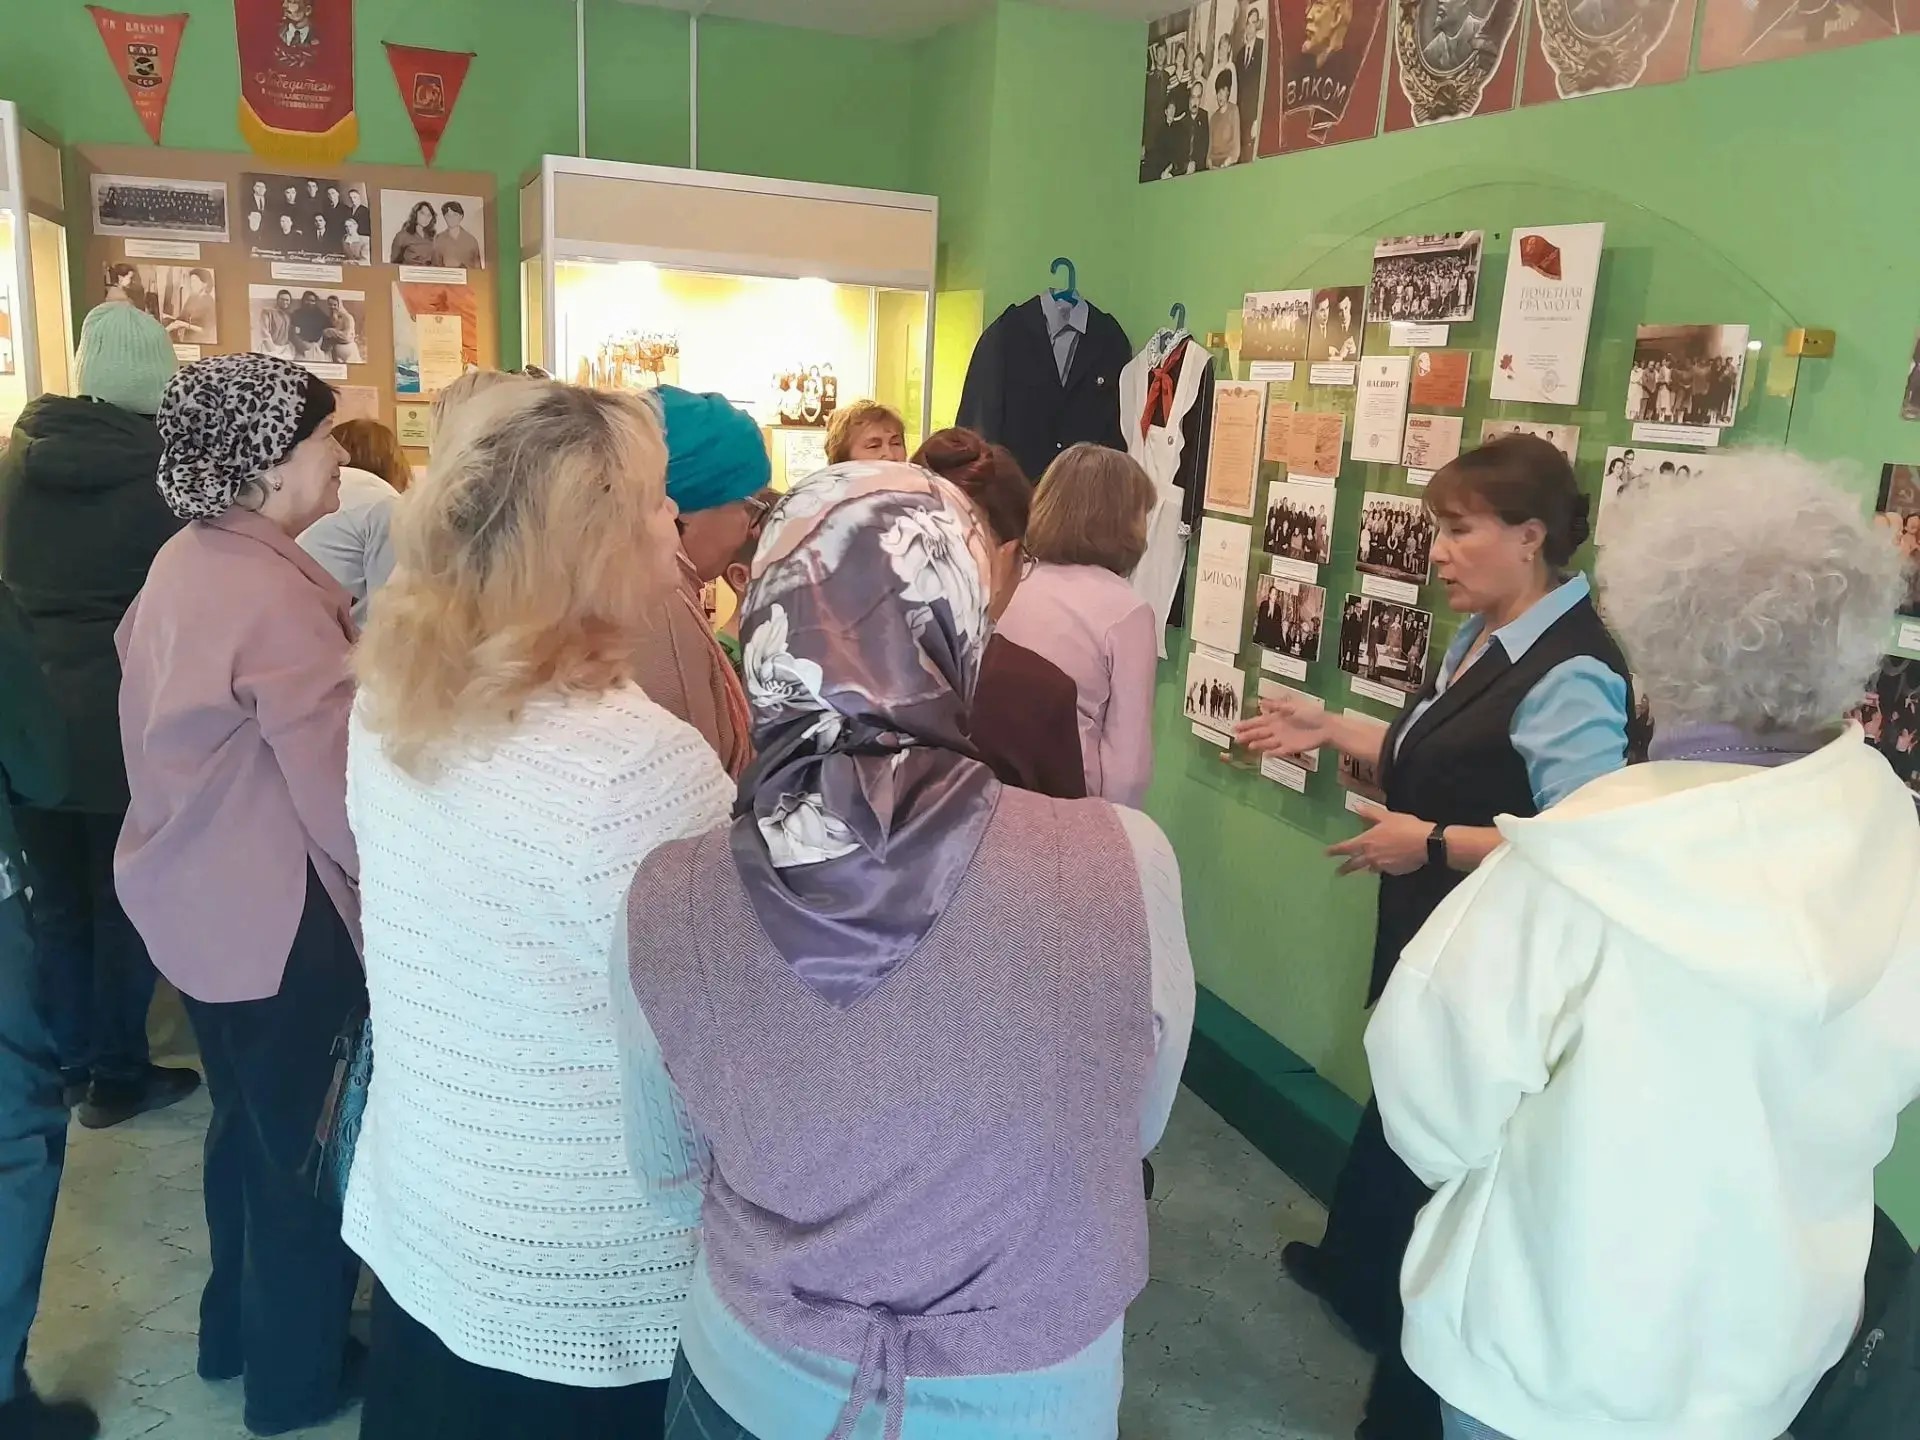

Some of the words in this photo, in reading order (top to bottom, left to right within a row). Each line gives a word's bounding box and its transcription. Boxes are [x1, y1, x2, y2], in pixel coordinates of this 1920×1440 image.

[126, 21, 164, 34] ВЛКСМ
[1287, 76, 1346, 105] ВЛКСМ
[1521, 287, 1583, 299] ПОЧЕТНАЯ
[1519, 299, 1580, 311] ГРАМОТА
[1366, 380, 1400, 388] ПАСПОРТ
[1201, 569, 1243, 591] ДИПЛОМ
